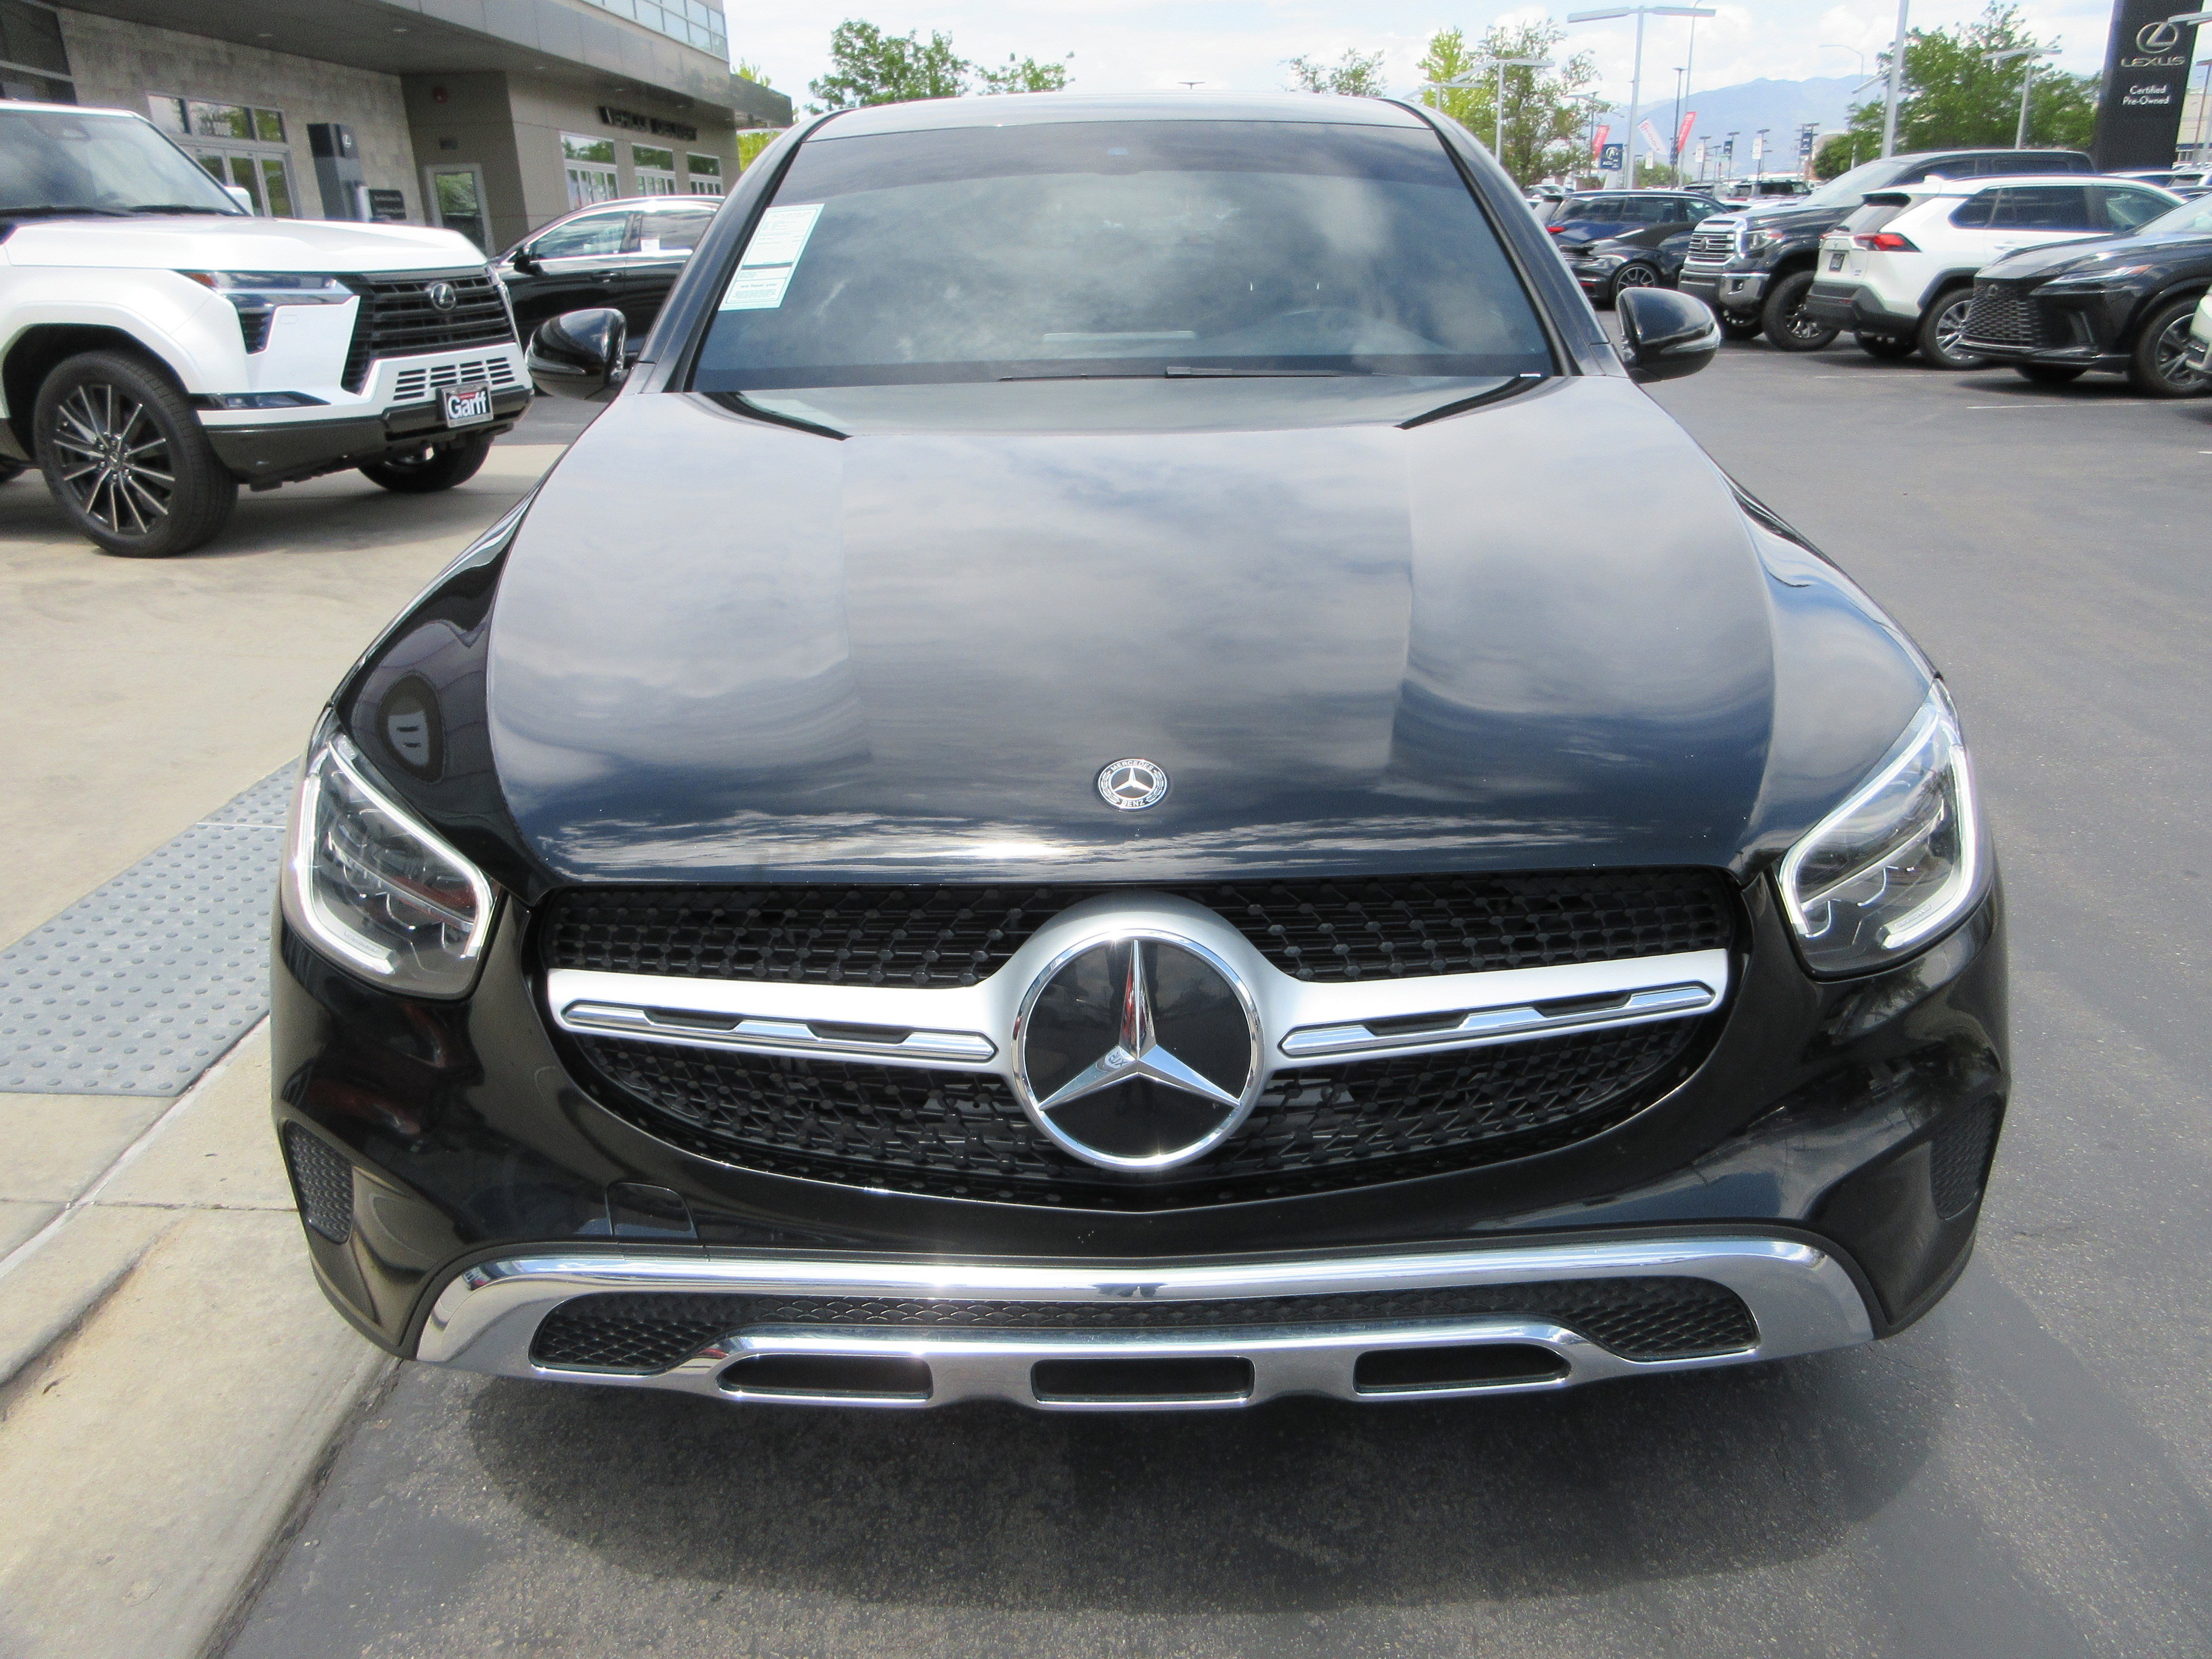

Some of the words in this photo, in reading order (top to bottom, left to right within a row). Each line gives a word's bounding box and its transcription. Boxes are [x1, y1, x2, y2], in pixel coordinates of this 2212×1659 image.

[2121, 56, 2185, 67] LEXUS
[2129, 84, 2167, 95] Certified
[2122, 95, 2171, 105] Pre-Owned
[448, 390, 486, 419] Garff
[1111, 761, 1154, 771] MERCEDES
[1121, 799, 1145, 807] BENZ
